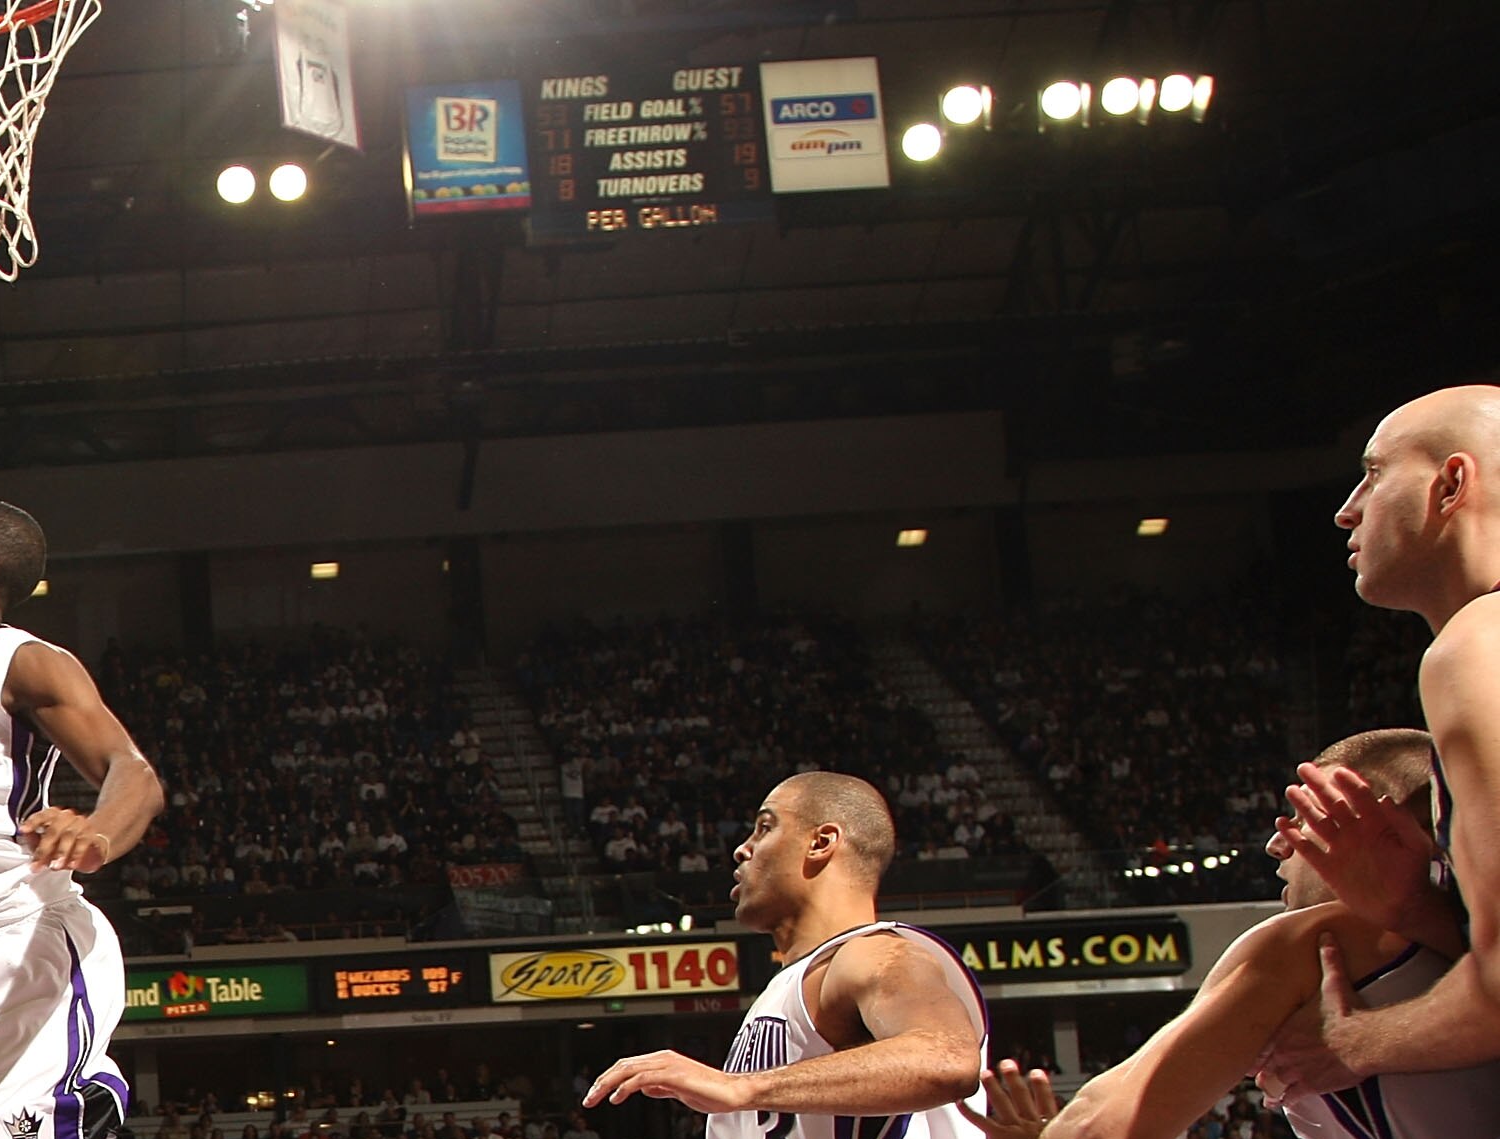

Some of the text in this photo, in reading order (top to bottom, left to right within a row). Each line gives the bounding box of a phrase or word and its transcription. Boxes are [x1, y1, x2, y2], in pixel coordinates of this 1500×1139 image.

[541, 67, 743, 99] KINGS GUEST
[443, 102, 491, 132] BR
[583, 102, 634, 122] FIELD
[779, 101, 836, 118] ARCO
[609, 148, 688, 171] ASSISTS
[598, 173, 705, 198] TURNOVERS
[586, 208, 628, 231] PER
[628, 946, 738, 990] 1140
[205, 977, 263, 1003] Table
[165, 1003, 207, 1015] PIZZA
